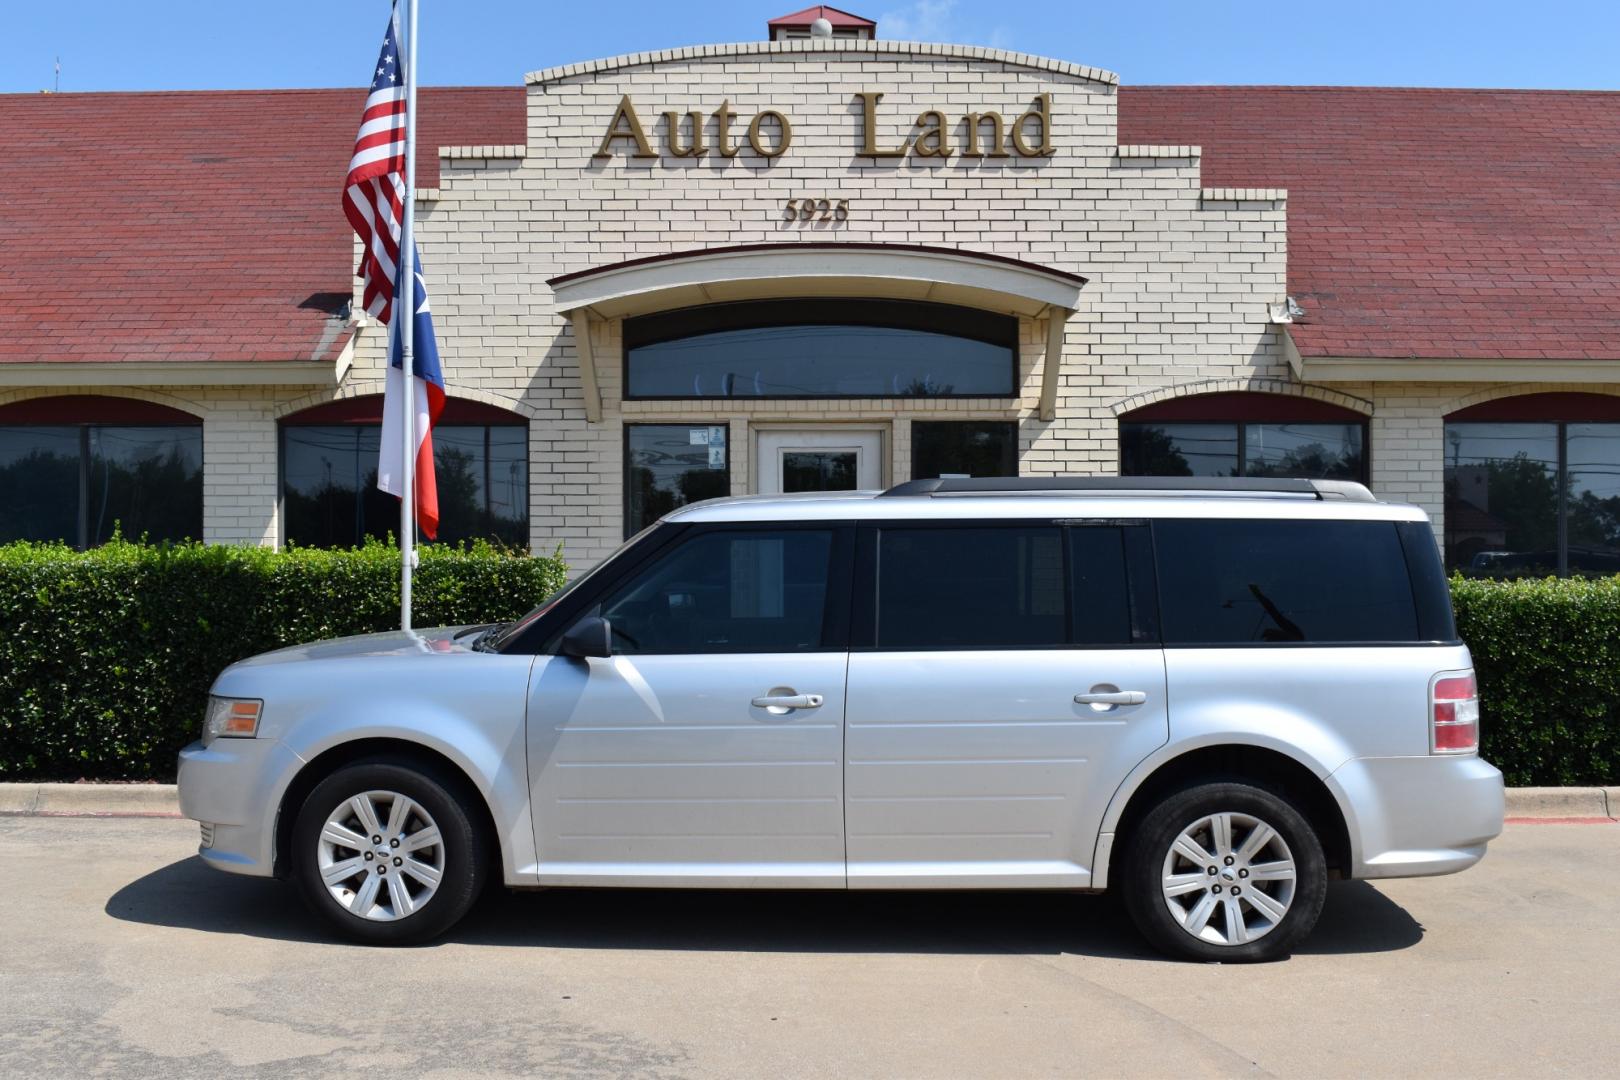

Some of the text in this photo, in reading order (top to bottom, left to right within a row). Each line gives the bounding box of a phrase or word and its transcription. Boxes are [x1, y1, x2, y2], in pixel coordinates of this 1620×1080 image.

[592, 92, 1057, 158] Auto Land
[785, 199, 849, 223] 5925
